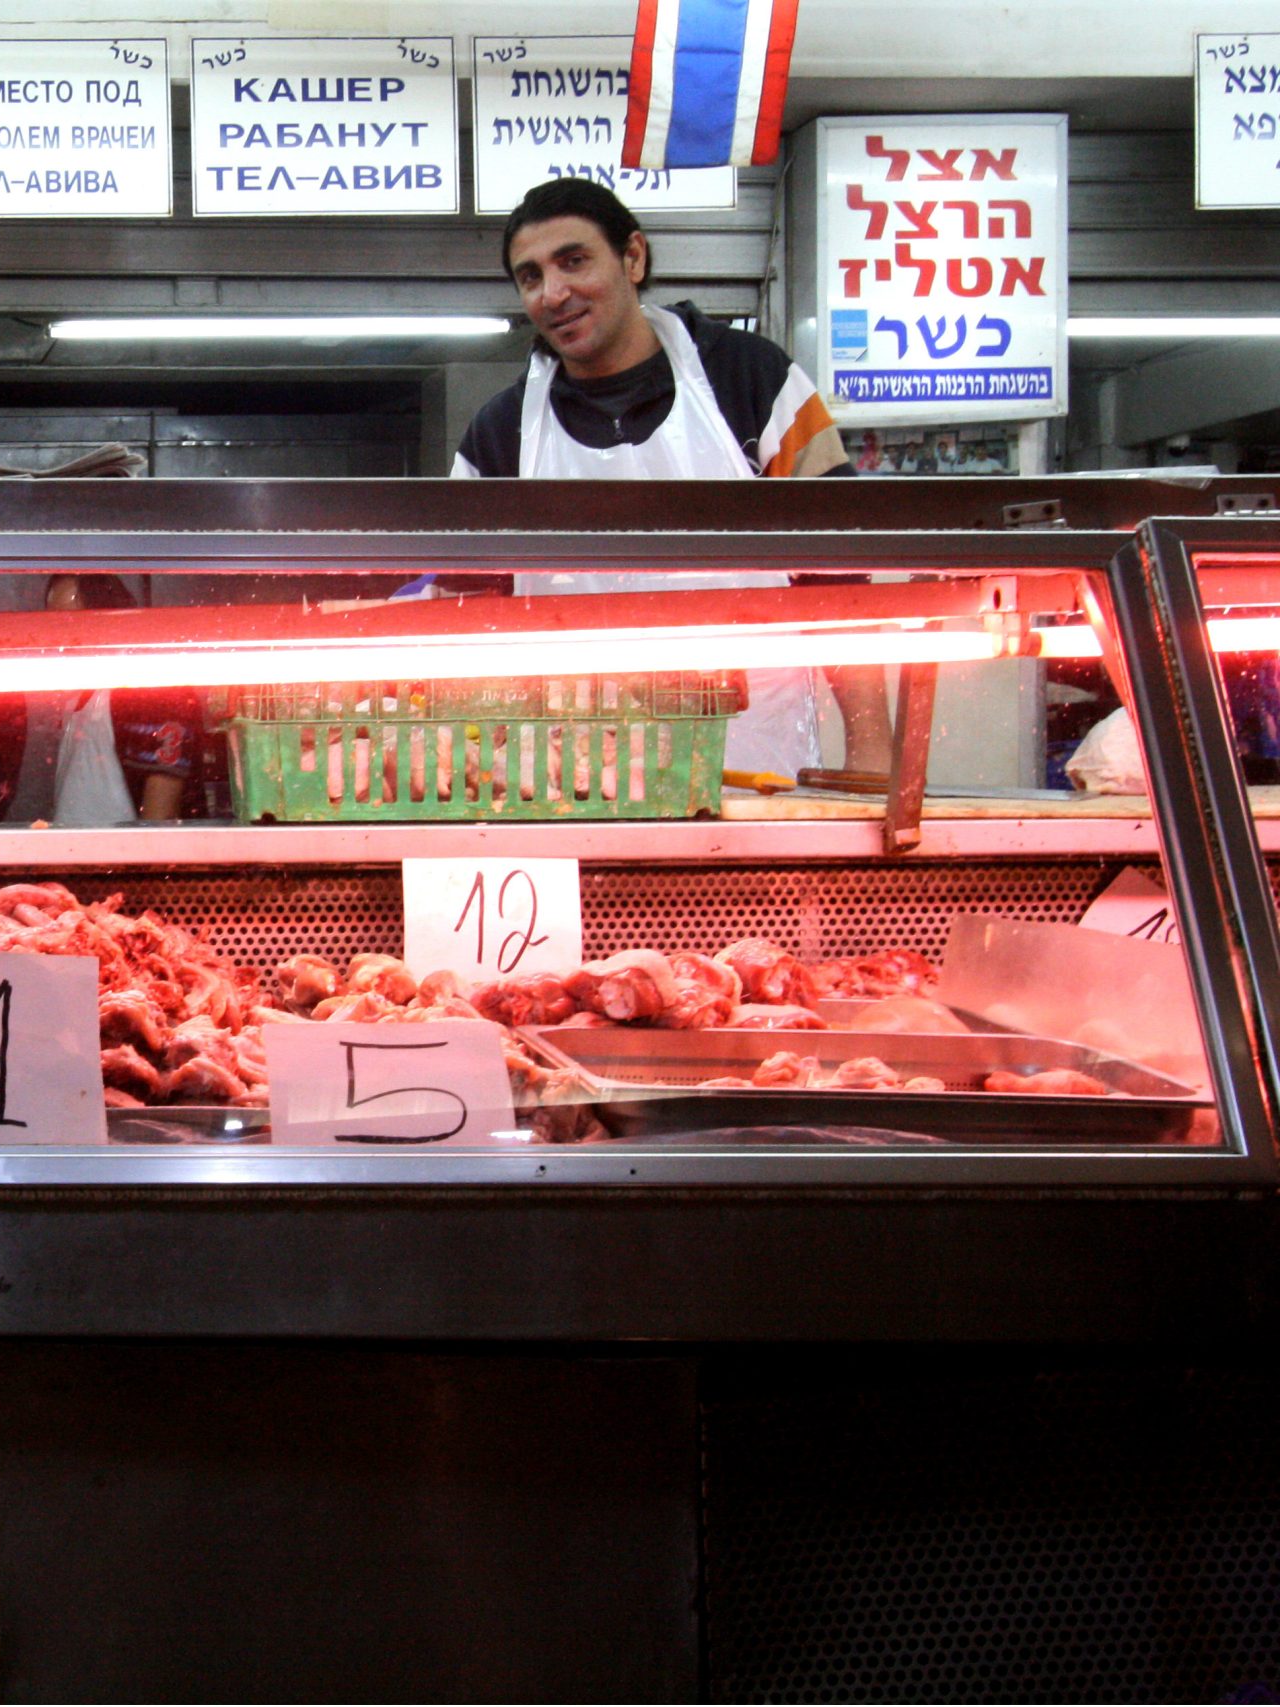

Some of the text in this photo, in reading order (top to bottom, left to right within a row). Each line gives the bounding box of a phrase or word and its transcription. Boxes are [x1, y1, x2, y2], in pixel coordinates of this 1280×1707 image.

[109, 45, 153, 70] כשר
[202, 48, 246, 70] כשר
[397, 43, 440, 69] כשר
[482, 45, 528, 64] כשר
[1206, 41, 1250, 61] כשר
[86, 79, 142, 107] ПОД
[233, 77, 406, 103] КАШЕР
[511, 66, 630, 97] בהשגחת
[219, 122, 429, 148] РАБАНУТ
[492, 115, 612, 145] הראשית
[865, 135, 1018, 181] אצל
[846, 184, 1032, 240] הרצל
[838, 243, 1047, 298] אטליז
[873, 314, 1012, 360] כשר
[872, 374, 931, 398] הראשית
[934, 373, 985, 397] הרבנות
[988, 372, 1049, 396] בהשגחת
[453, 868, 549, 974] 12
[334, 1039, 468, 1143] 5
